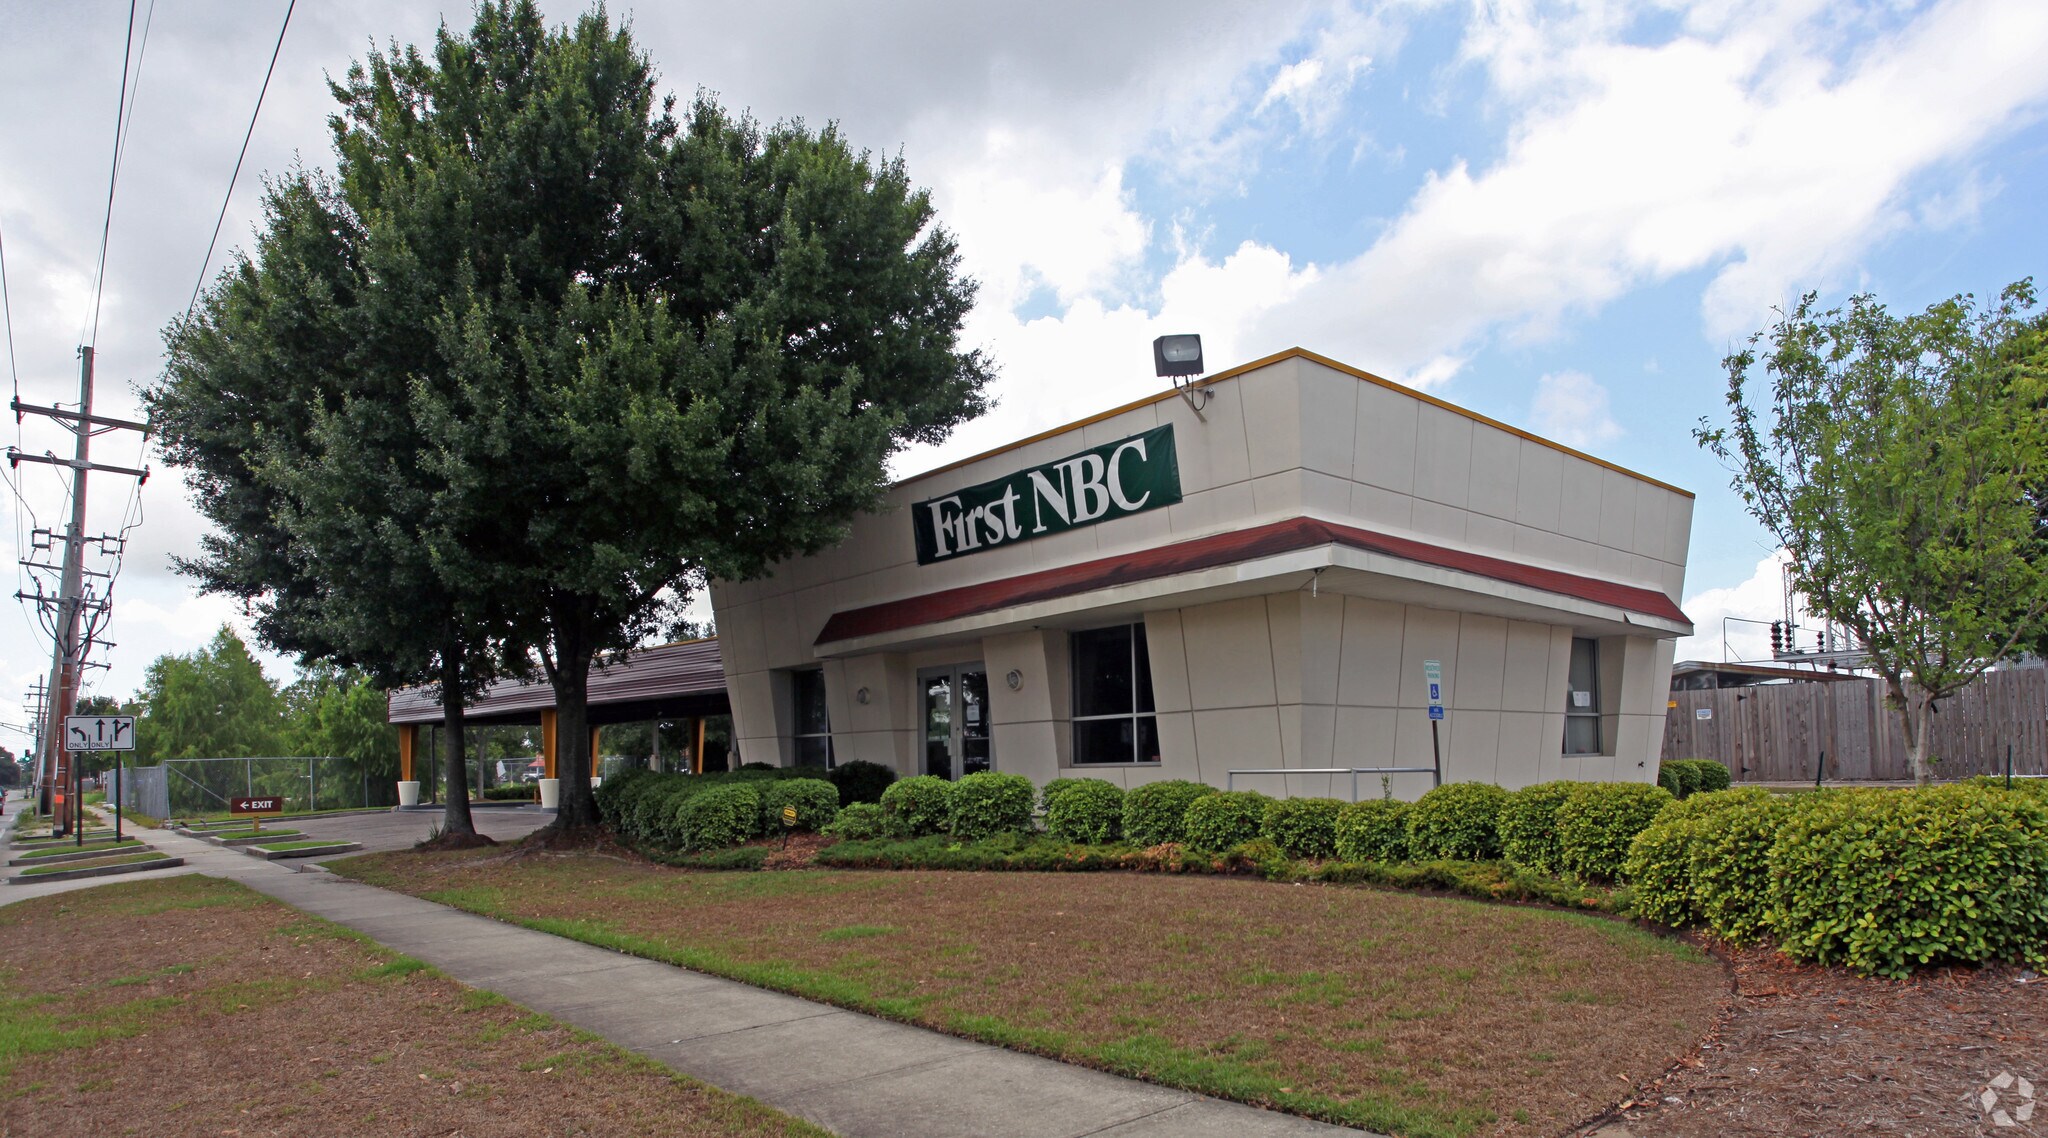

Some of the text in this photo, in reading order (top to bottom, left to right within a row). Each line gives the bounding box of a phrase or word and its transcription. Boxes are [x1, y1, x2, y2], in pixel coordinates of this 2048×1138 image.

[927, 437, 1151, 558] First NBC
[251, 800, 273, 809] EXIT
